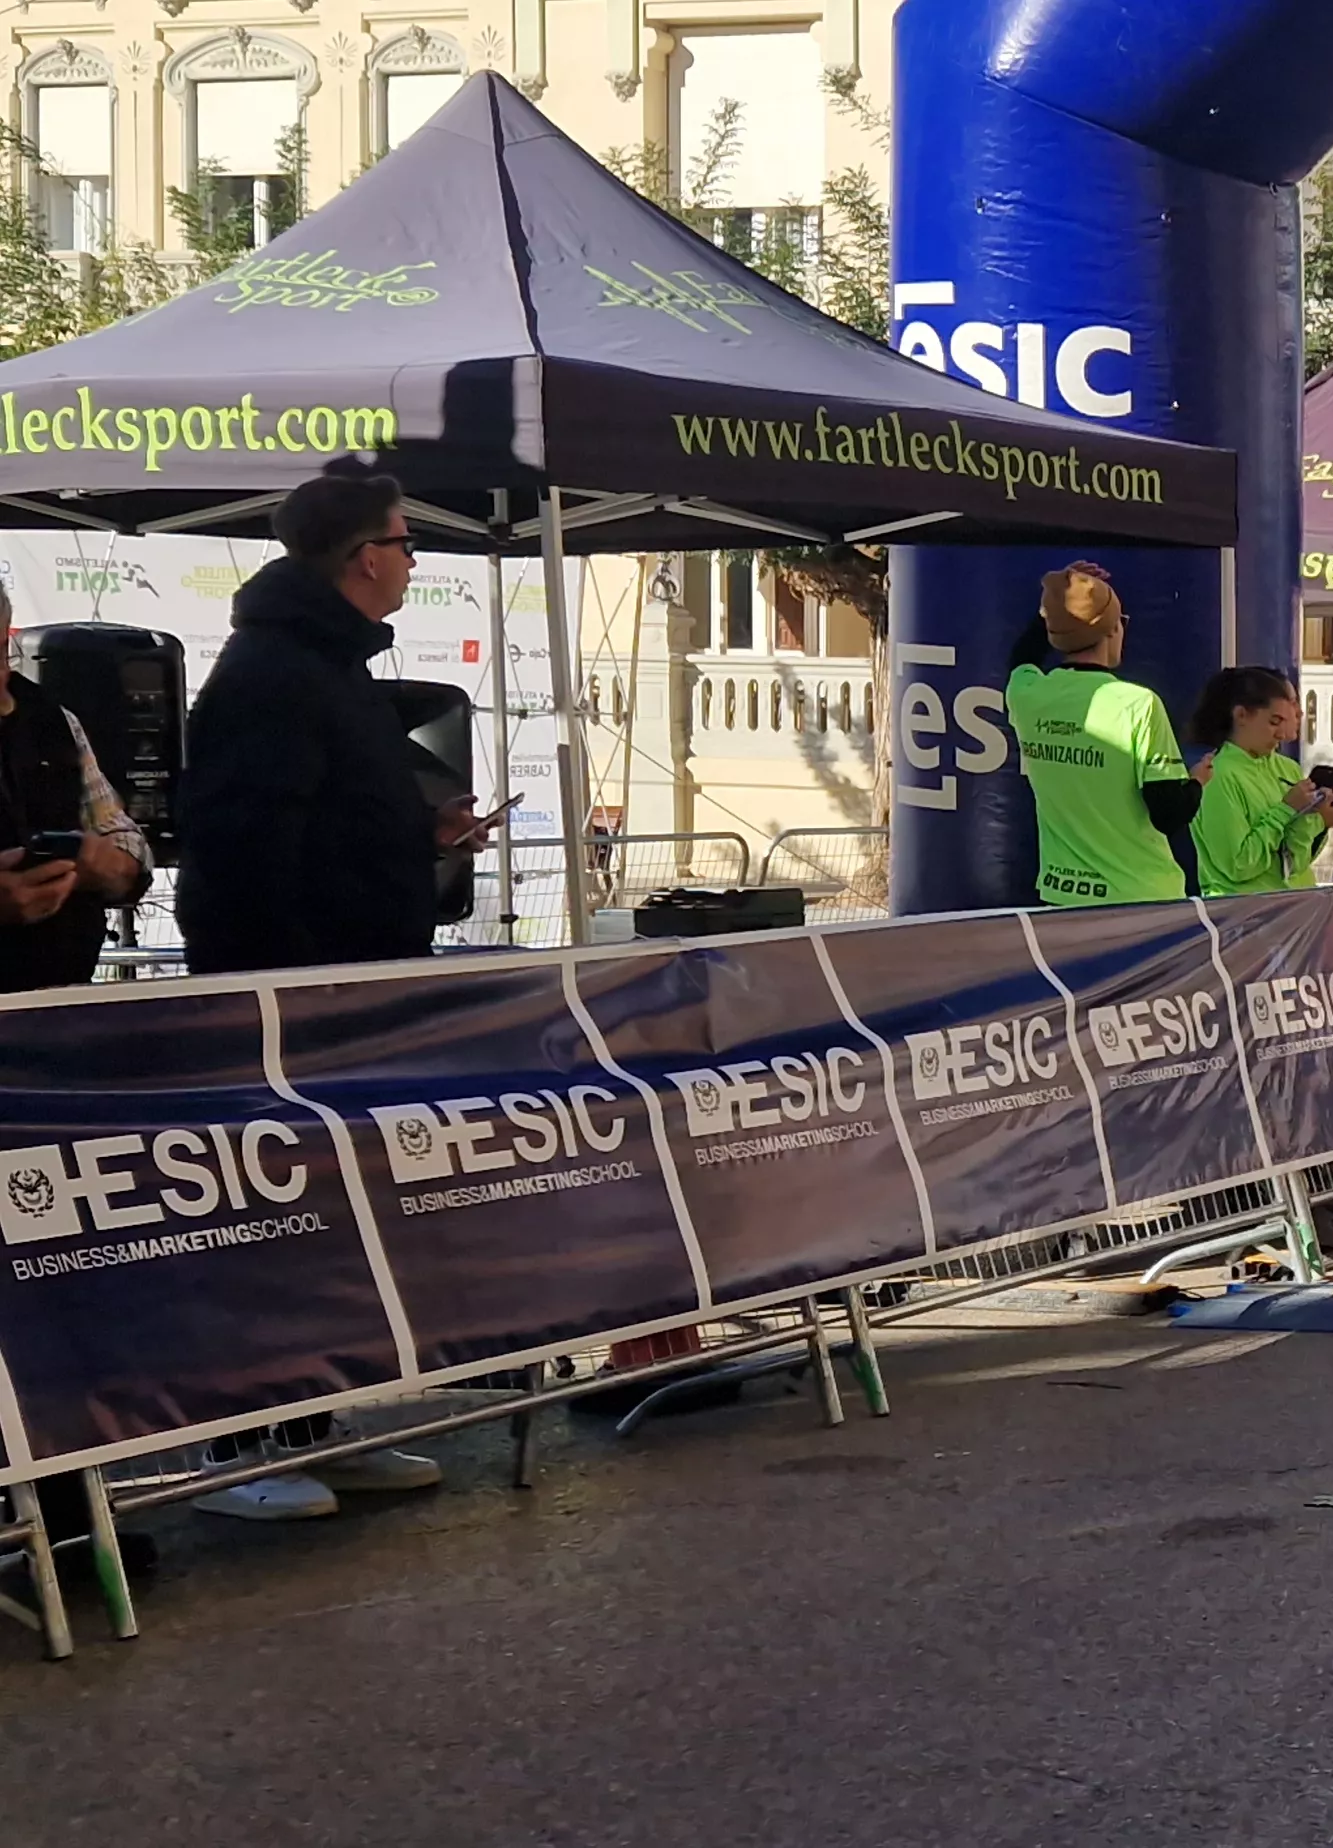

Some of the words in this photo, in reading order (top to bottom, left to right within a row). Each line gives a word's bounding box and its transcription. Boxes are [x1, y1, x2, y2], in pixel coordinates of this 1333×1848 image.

[0, 386, 398, 471] lecksport.com
[672, 406, 1163, 504] www.fartlecksport.com
[946, 1015, 1058, 1094] ESIC
[1119, 990, 1220, 1062] ESIC
[718, 1047, 866, 1129] ESIC
[434, 1084, 625, 1174] ESIC
[695, 1120, 880, 1166] BUSINESS&MARKETINGSCHOOL
[70, 1119, 308, 1231] ESIC
[399, 1160, 643, 1216] BUSINESS&MARKETINGSCHOOL
[11, 1211, 331, 1281] BUSINESS&MARKETINGSCHOOL
